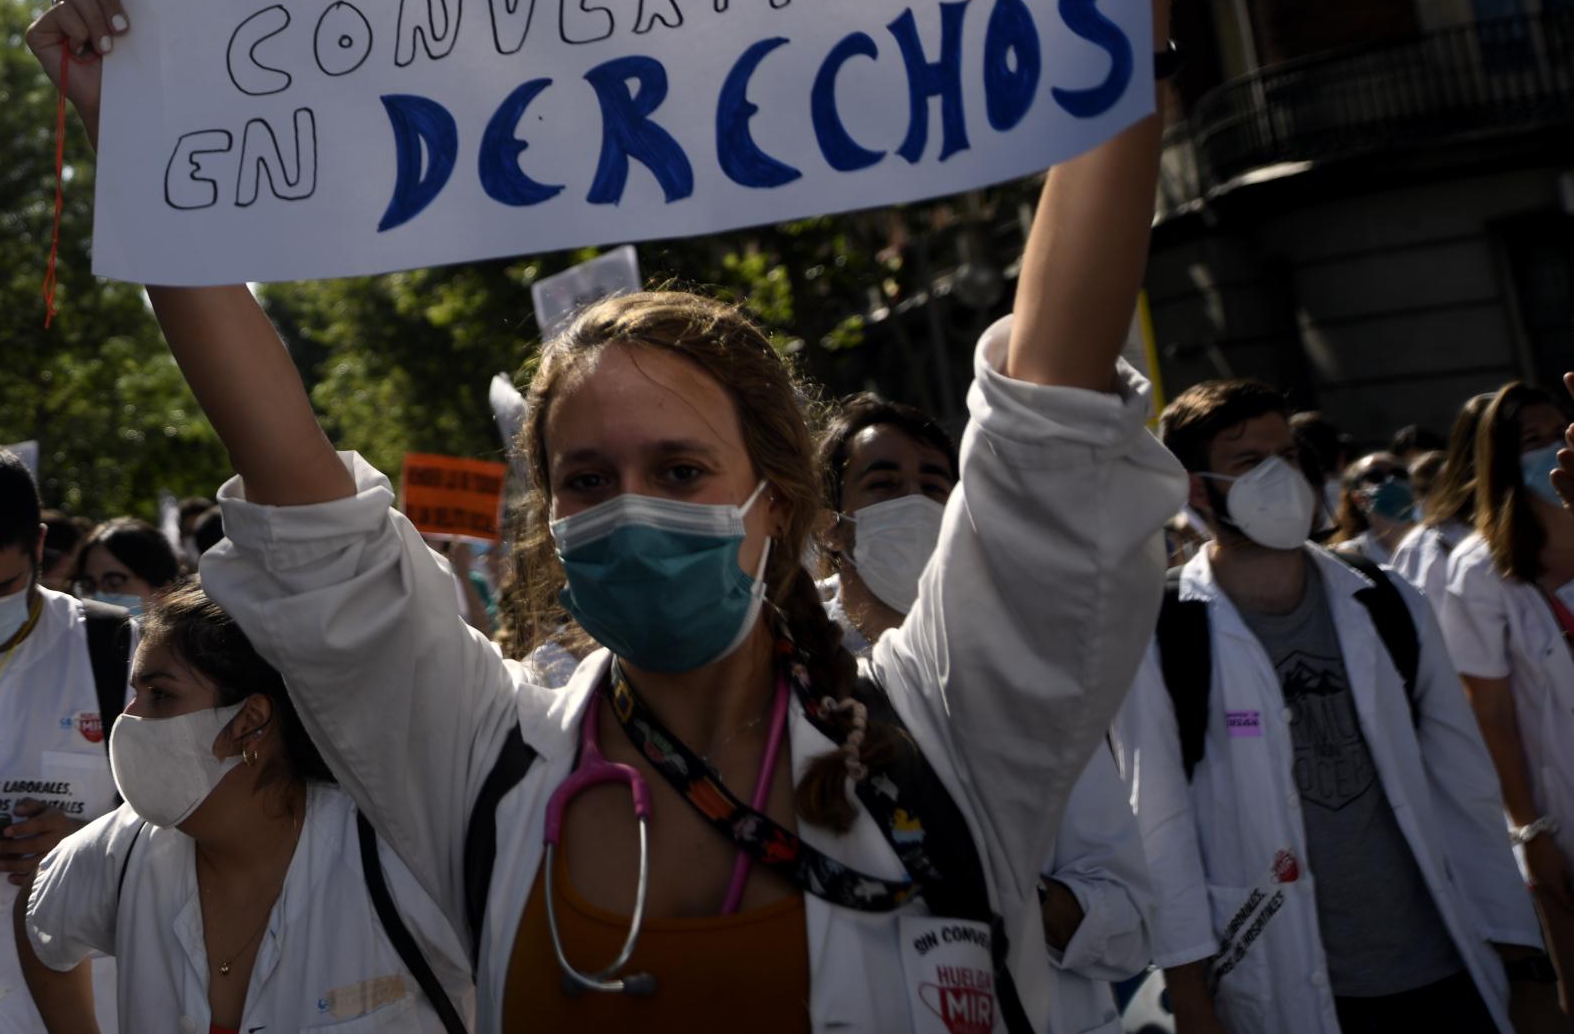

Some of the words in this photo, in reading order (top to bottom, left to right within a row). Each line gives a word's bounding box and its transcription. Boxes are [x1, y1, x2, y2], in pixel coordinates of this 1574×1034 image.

[163, 107, 317, 210] EN
[913, 930, 939, 956] SIN
[946, 988, 993, 1027] MIR
